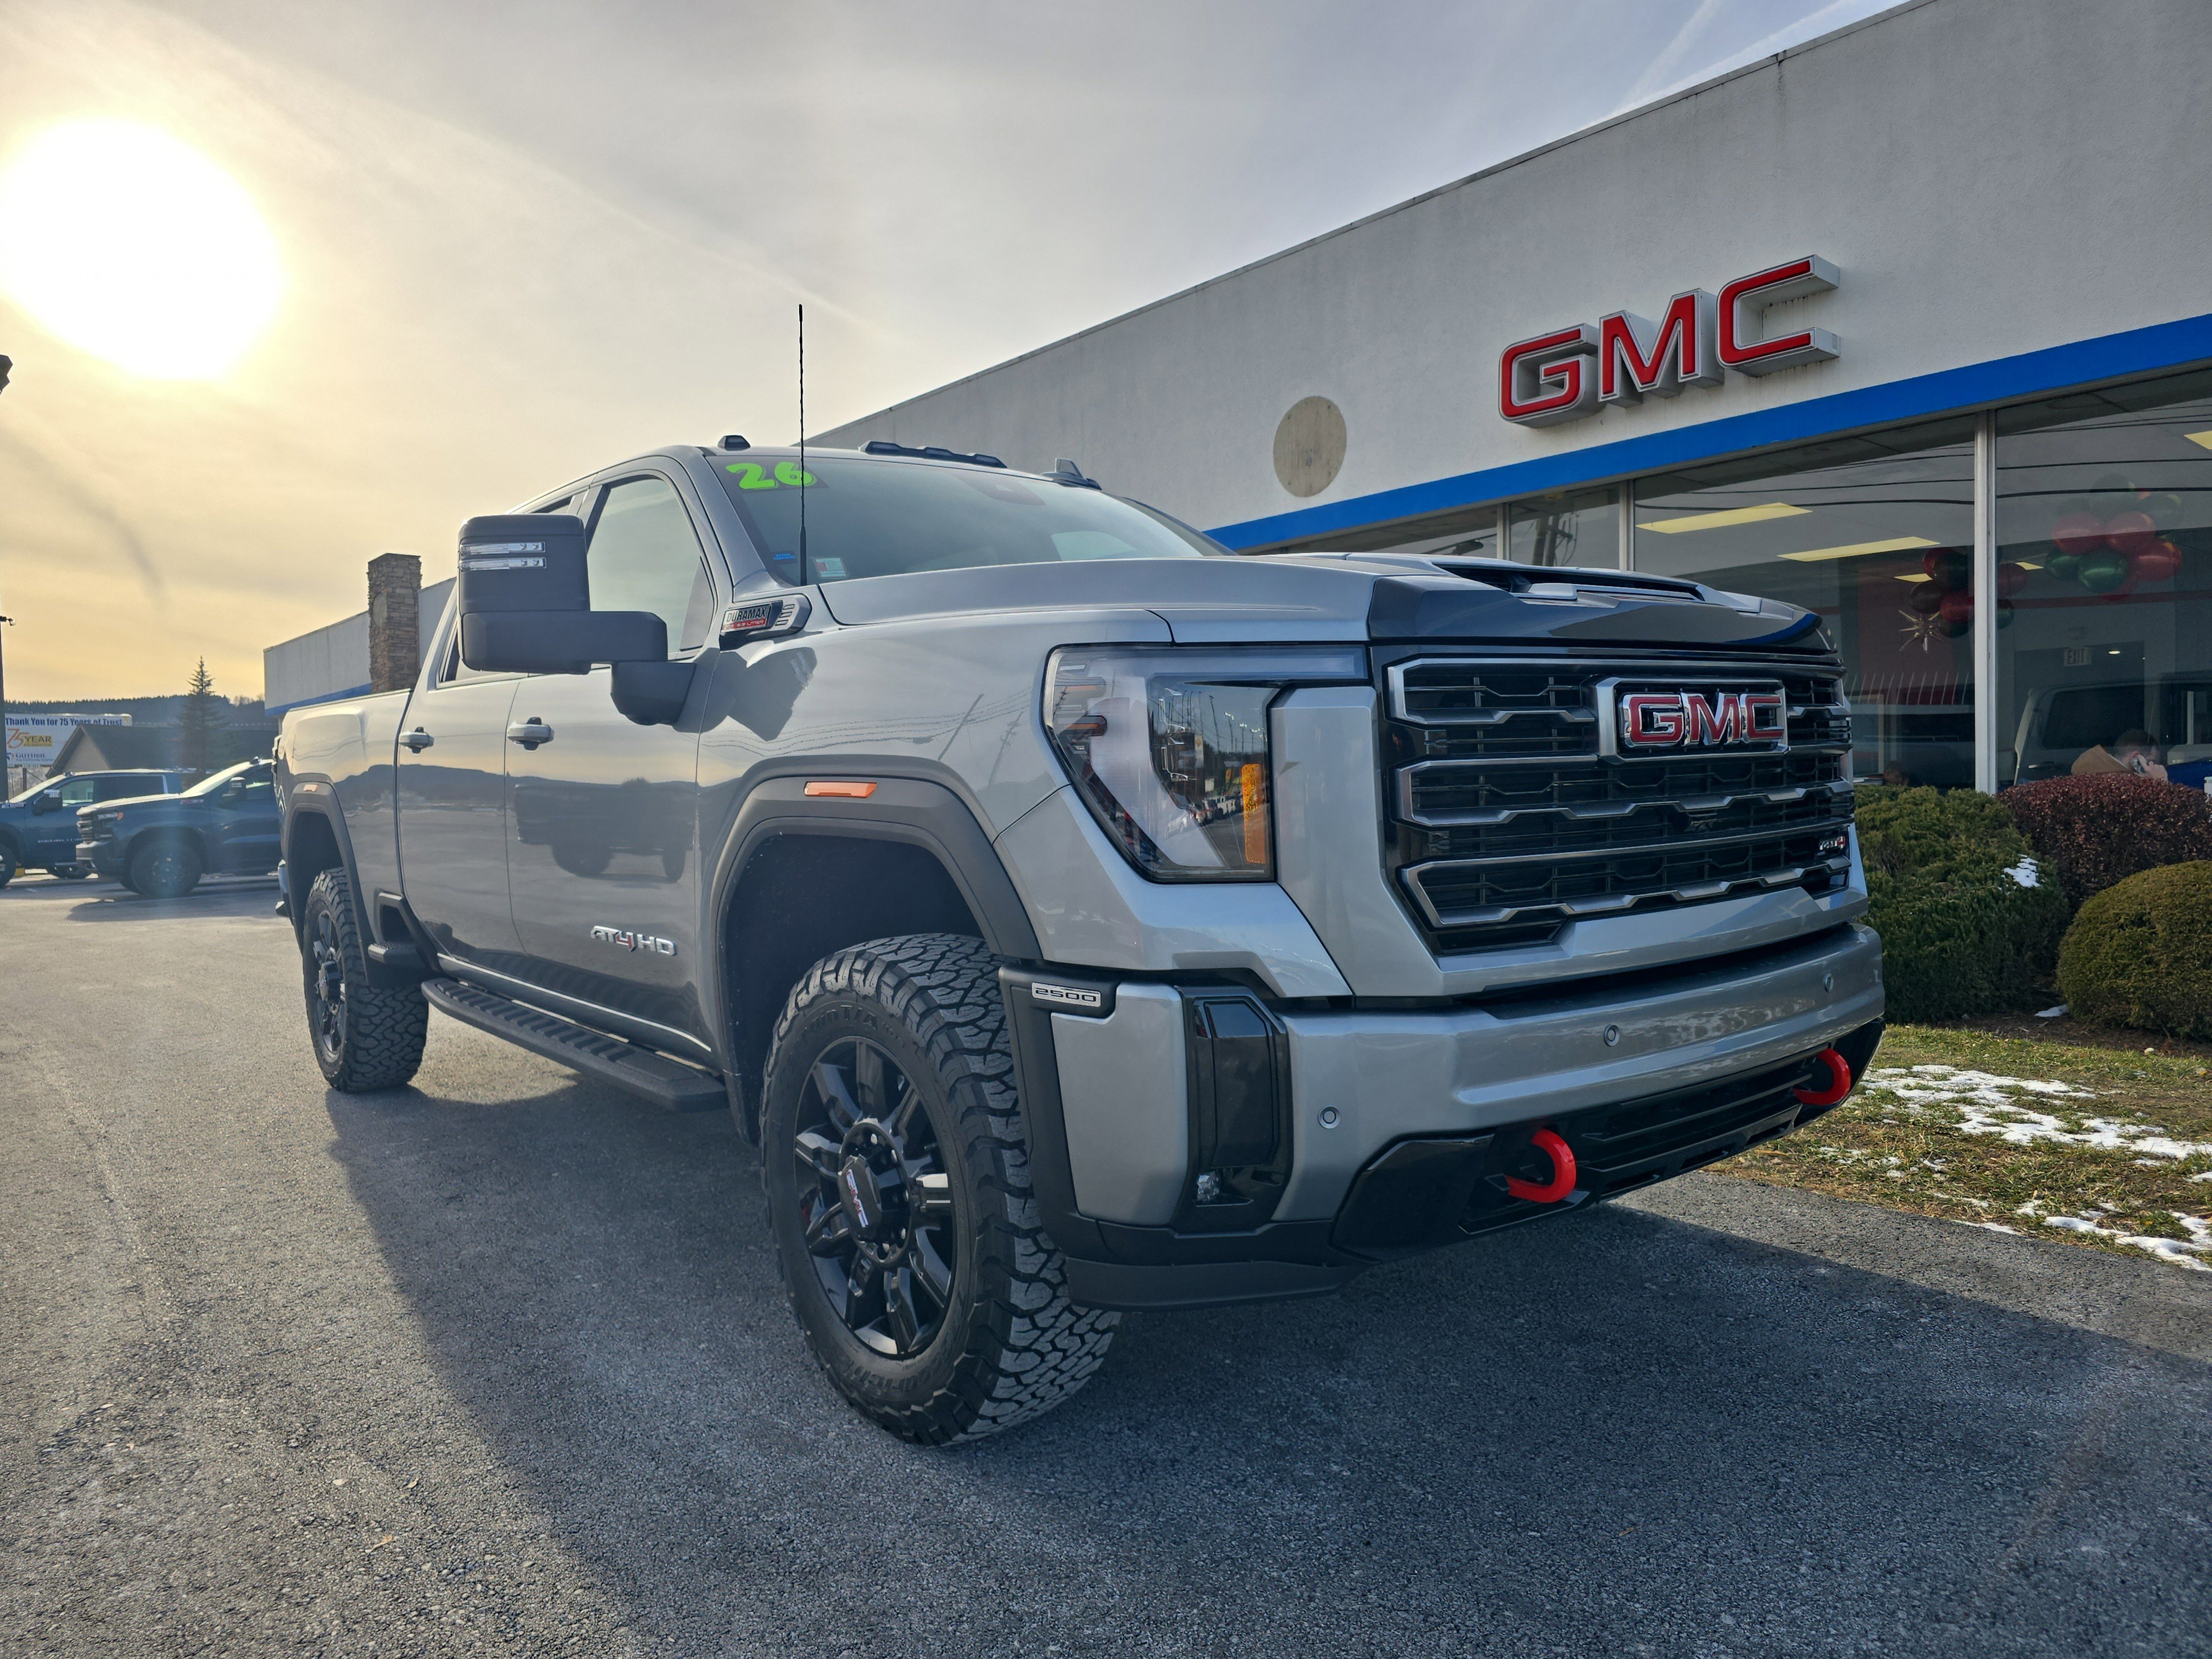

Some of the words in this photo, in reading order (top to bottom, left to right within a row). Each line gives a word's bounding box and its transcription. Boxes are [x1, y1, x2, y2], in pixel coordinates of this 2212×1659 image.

[1499, 254, 1840, 427] GMC
[725, 461, 815, 490] 26
[727, 607, 767, 622] DURAMAX
[2067, 648, 2085, 665] EXIT
[1623, 692, 1784, 748] GMC
[7, 728, 29, 748] 75
[1036, 988, 1096, 1002] 2500
